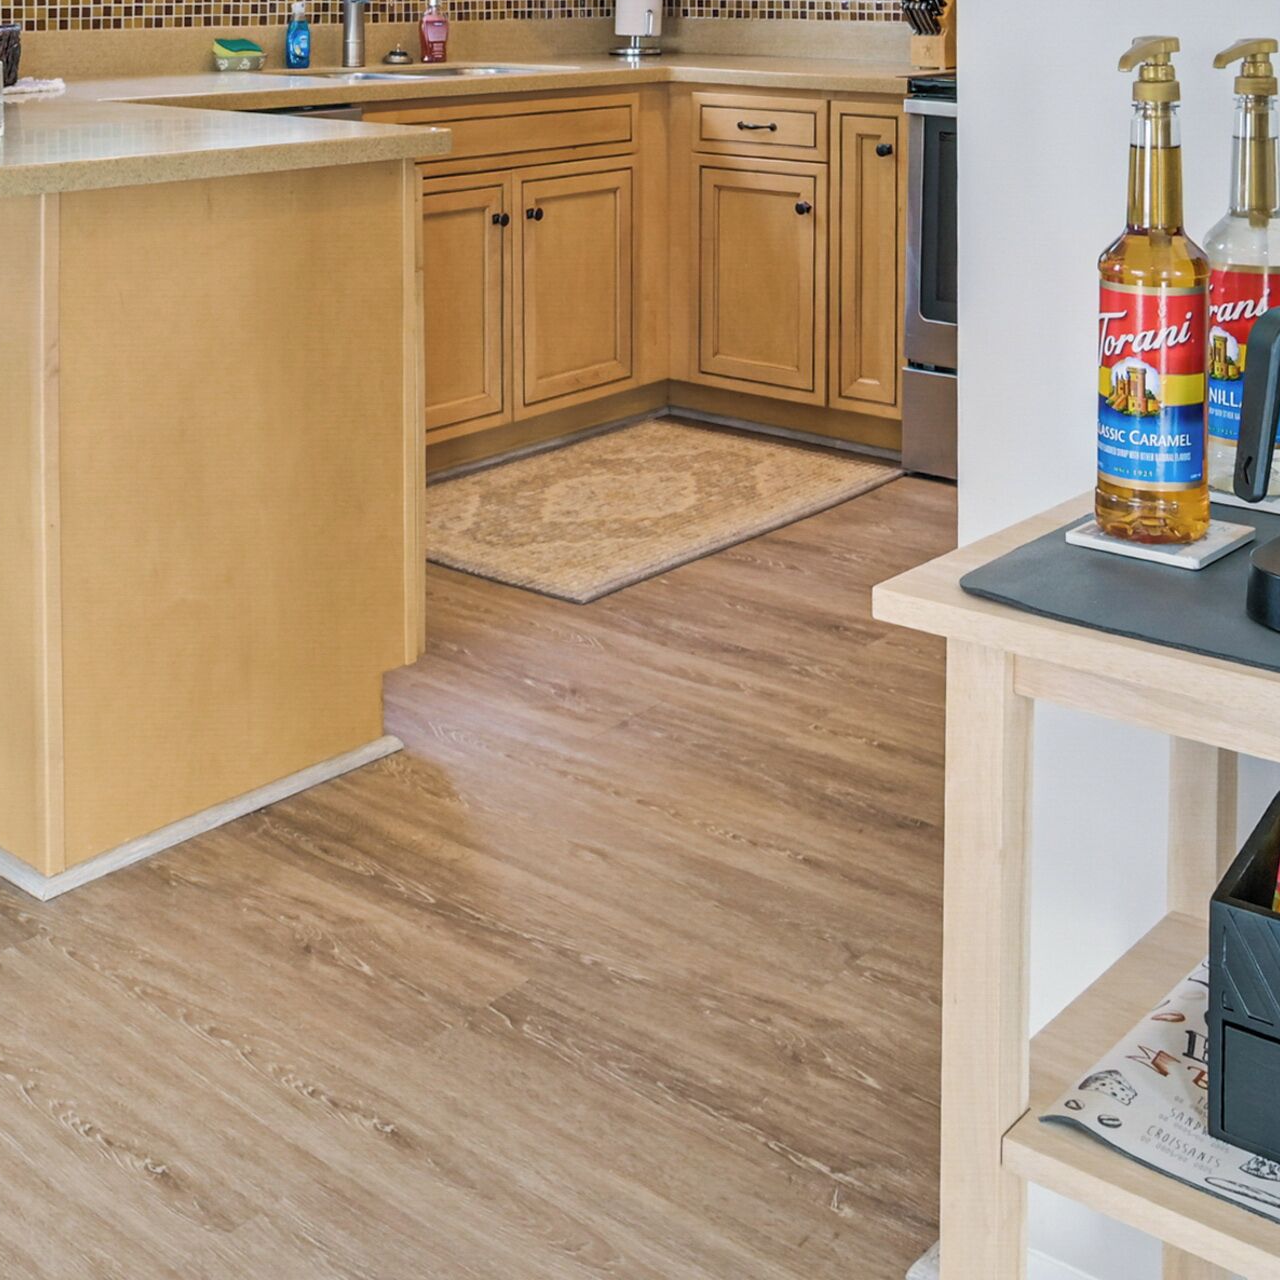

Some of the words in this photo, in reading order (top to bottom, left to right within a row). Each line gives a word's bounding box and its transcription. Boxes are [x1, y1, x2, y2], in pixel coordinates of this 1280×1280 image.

[1208, 285, 1270, 323] rani
[1098, 310, 1193, 367] Torani
[1208, 387, 1242, 408] NILL
[1129, 429, 1192, 448] CARAMEL
[1146, 1125, 1222, 1168] CROISSANTS
